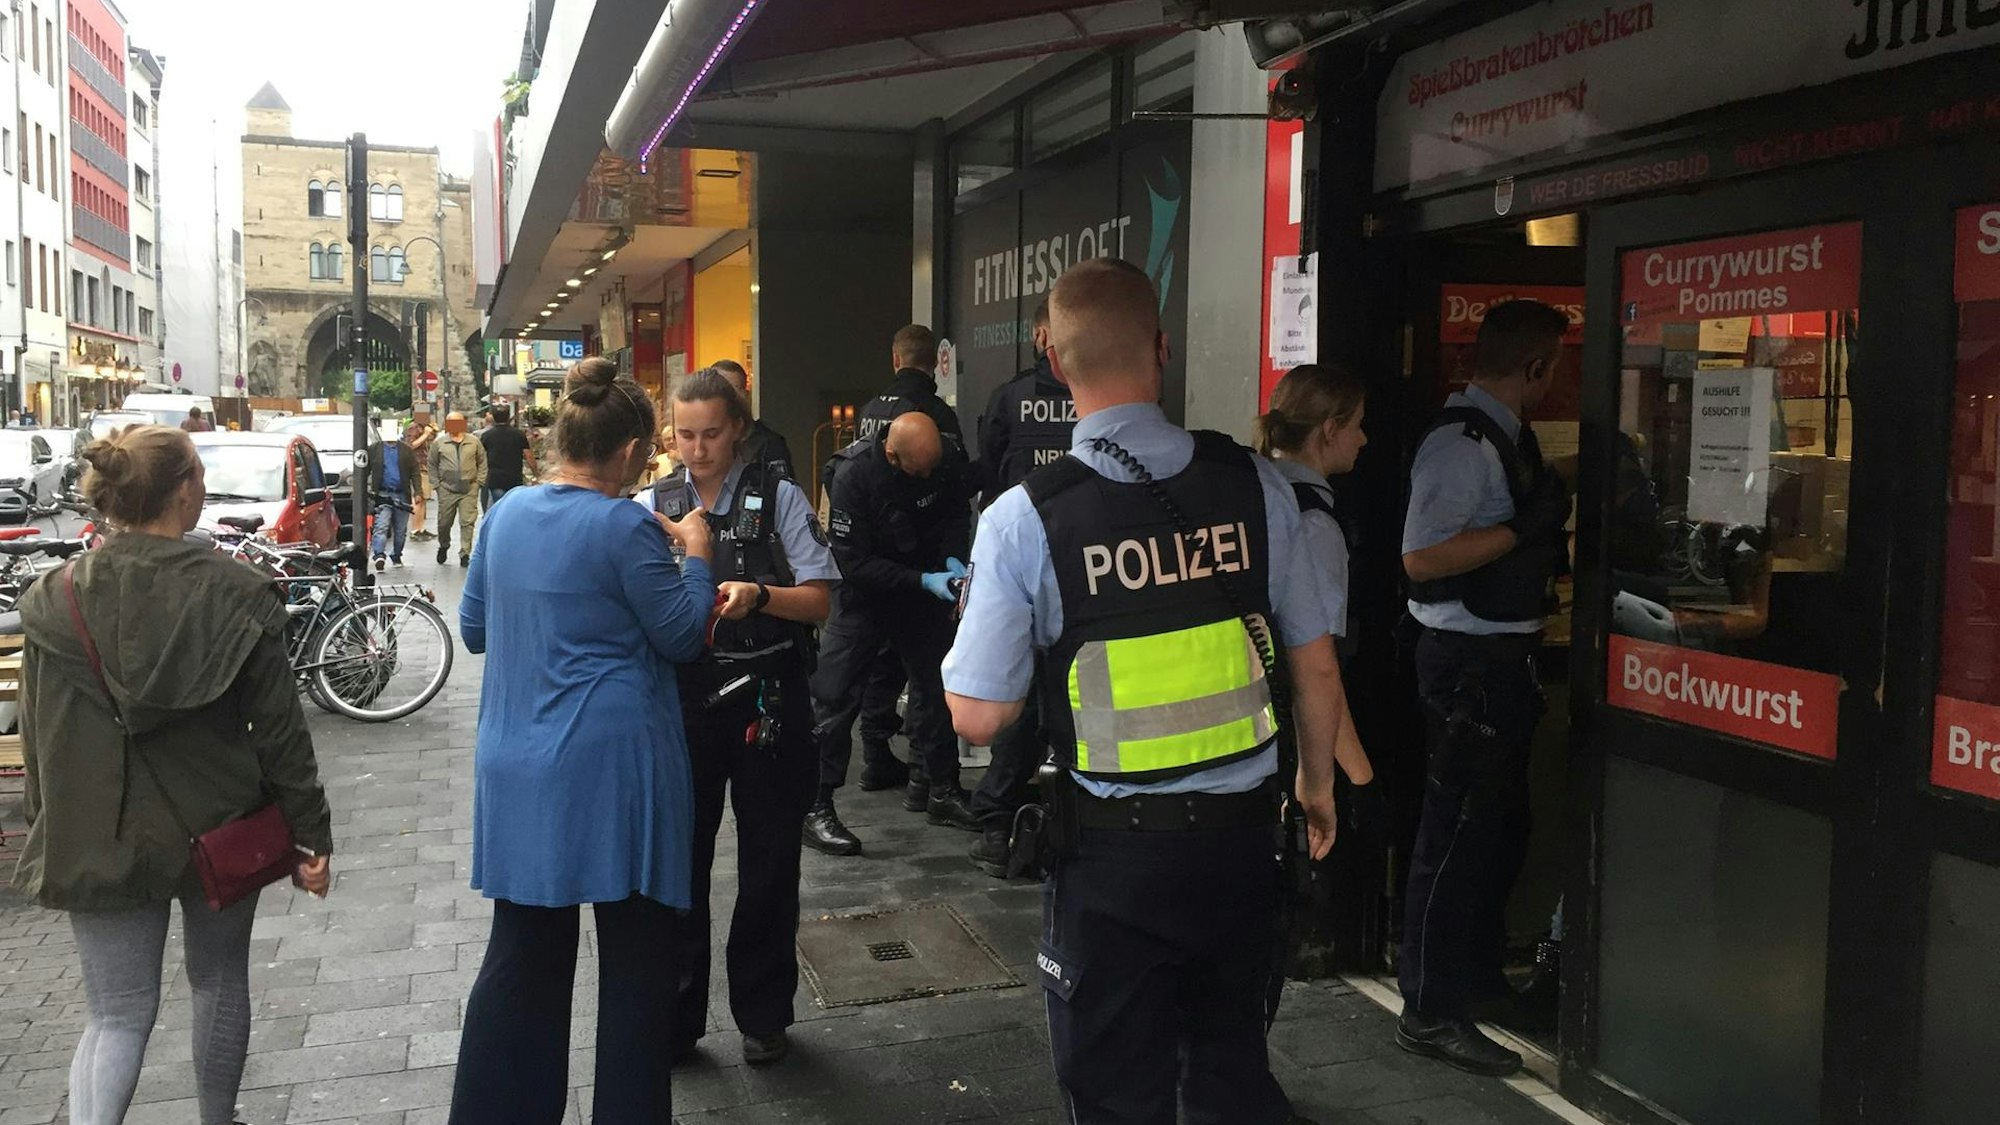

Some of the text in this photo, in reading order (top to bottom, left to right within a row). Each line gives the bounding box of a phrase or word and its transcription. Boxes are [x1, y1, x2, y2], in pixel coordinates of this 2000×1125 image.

[1408, 2, 1654, 108] Spießbratenbrötchen
[1451, 79, 1588, 143] Currywurst
[1529, 180, 1568, 204] WER
[1644, 234, 1823, 289] Currywurst
[1678, 286, 1788, 315] Pommes
[1083, 522, 1250, 595] POLIZEI
[1623, 654, 1803, 728] Bockwurst
